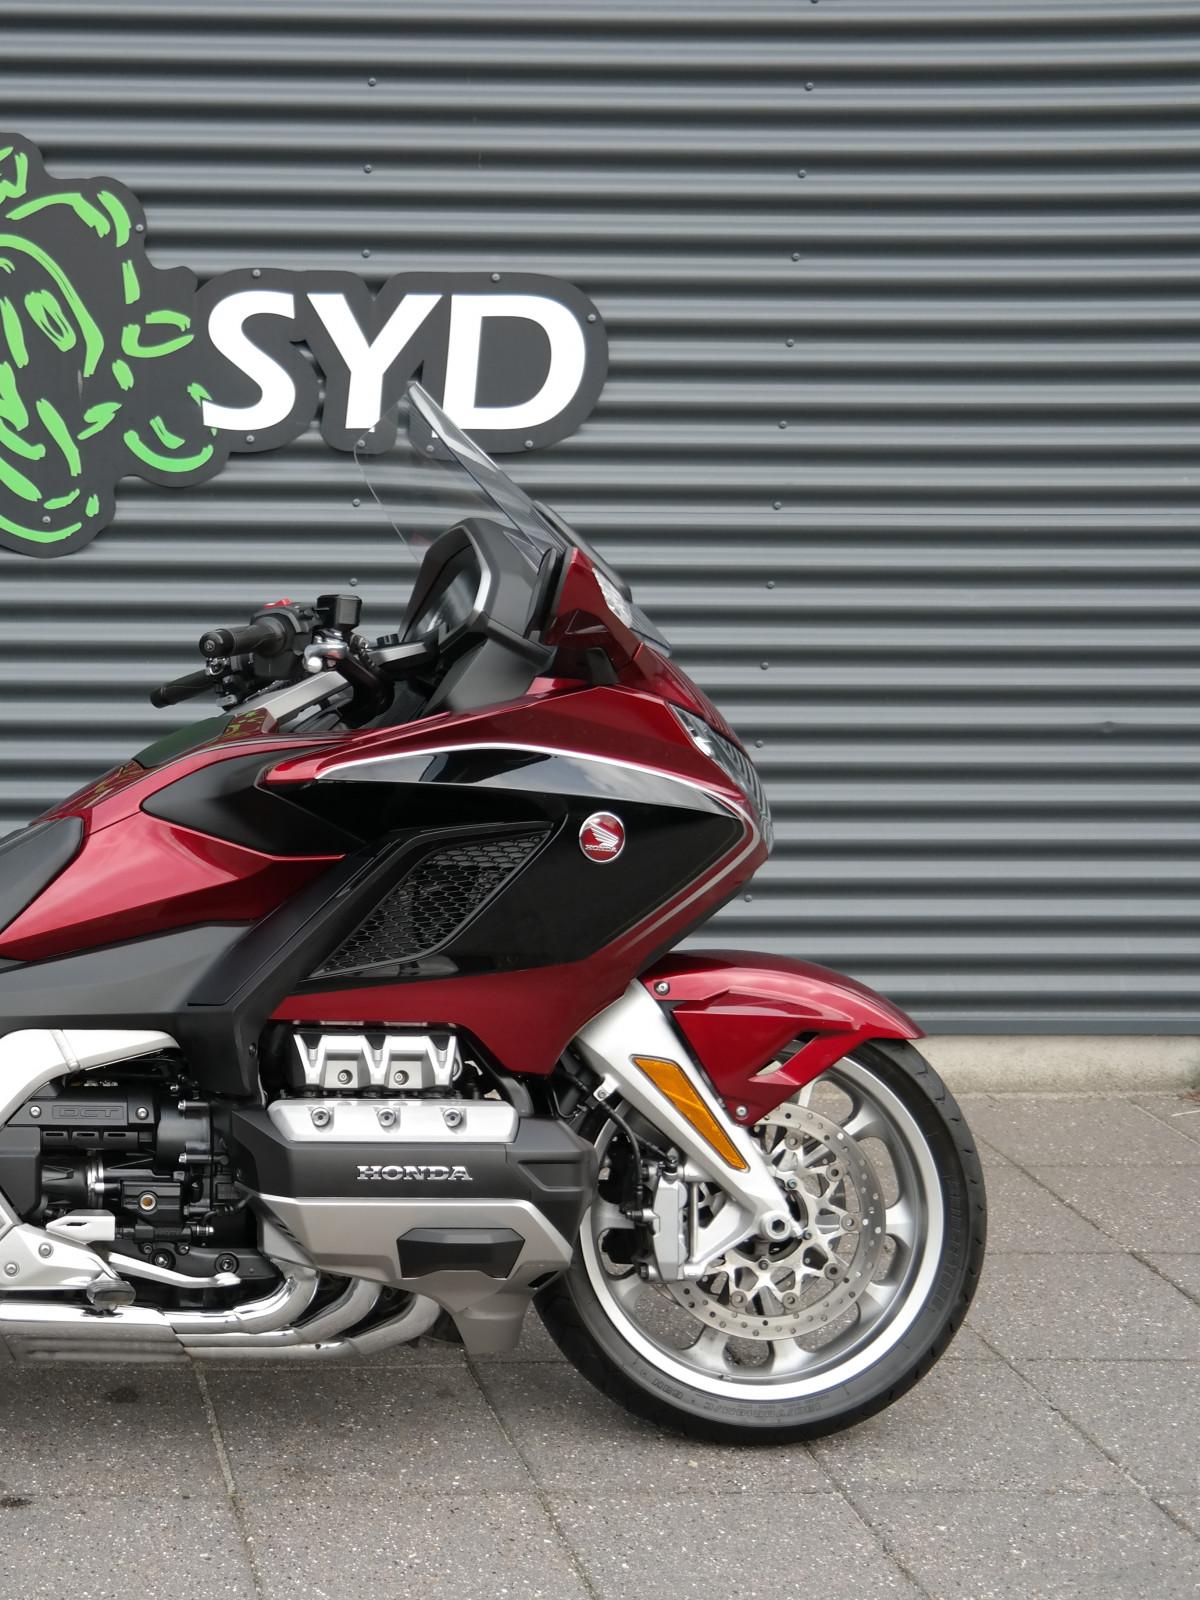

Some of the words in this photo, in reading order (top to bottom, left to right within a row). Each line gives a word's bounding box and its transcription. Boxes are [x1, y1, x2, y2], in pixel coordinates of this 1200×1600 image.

[203, 290, 586, 432] SYD
[59, 1107, 121, 1118] DCT
[356, 1165, 473, 1180] HONDA
